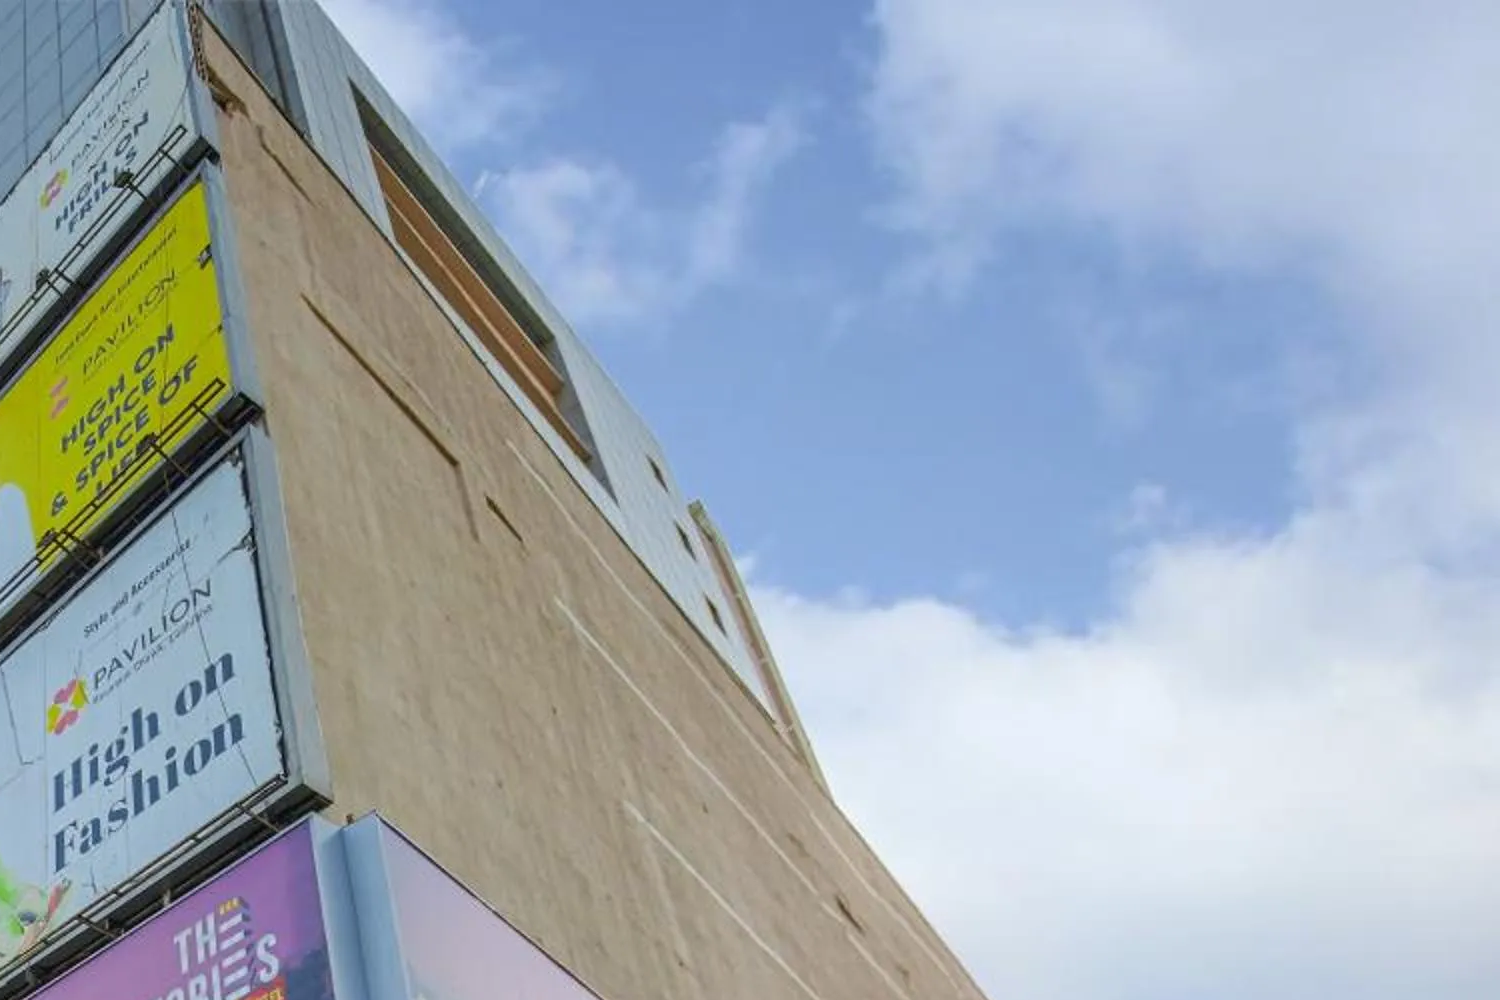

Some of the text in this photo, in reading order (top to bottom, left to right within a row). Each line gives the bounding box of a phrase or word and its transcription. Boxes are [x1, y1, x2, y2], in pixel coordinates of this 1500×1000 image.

[55, 161, 107, 231] HIGH
[114, 111, 149, 157] ON
[83, 267, 176, 375] PAVILION
[61, 372, 125, 453] HIGH
[133, 322, 176, 374] ON
[75, 404, 150, 492] SPICE
[158, 354, 199, 405] OF
[83, 367, 156, 456] SPICE
[93, 577, 211, 690] PAVILION
[53, 706, 161, 813] High
[173, 651, 235, 717] on
[53, 712, 244, 874] Fashion
[172, 898, 247, 974] THE
